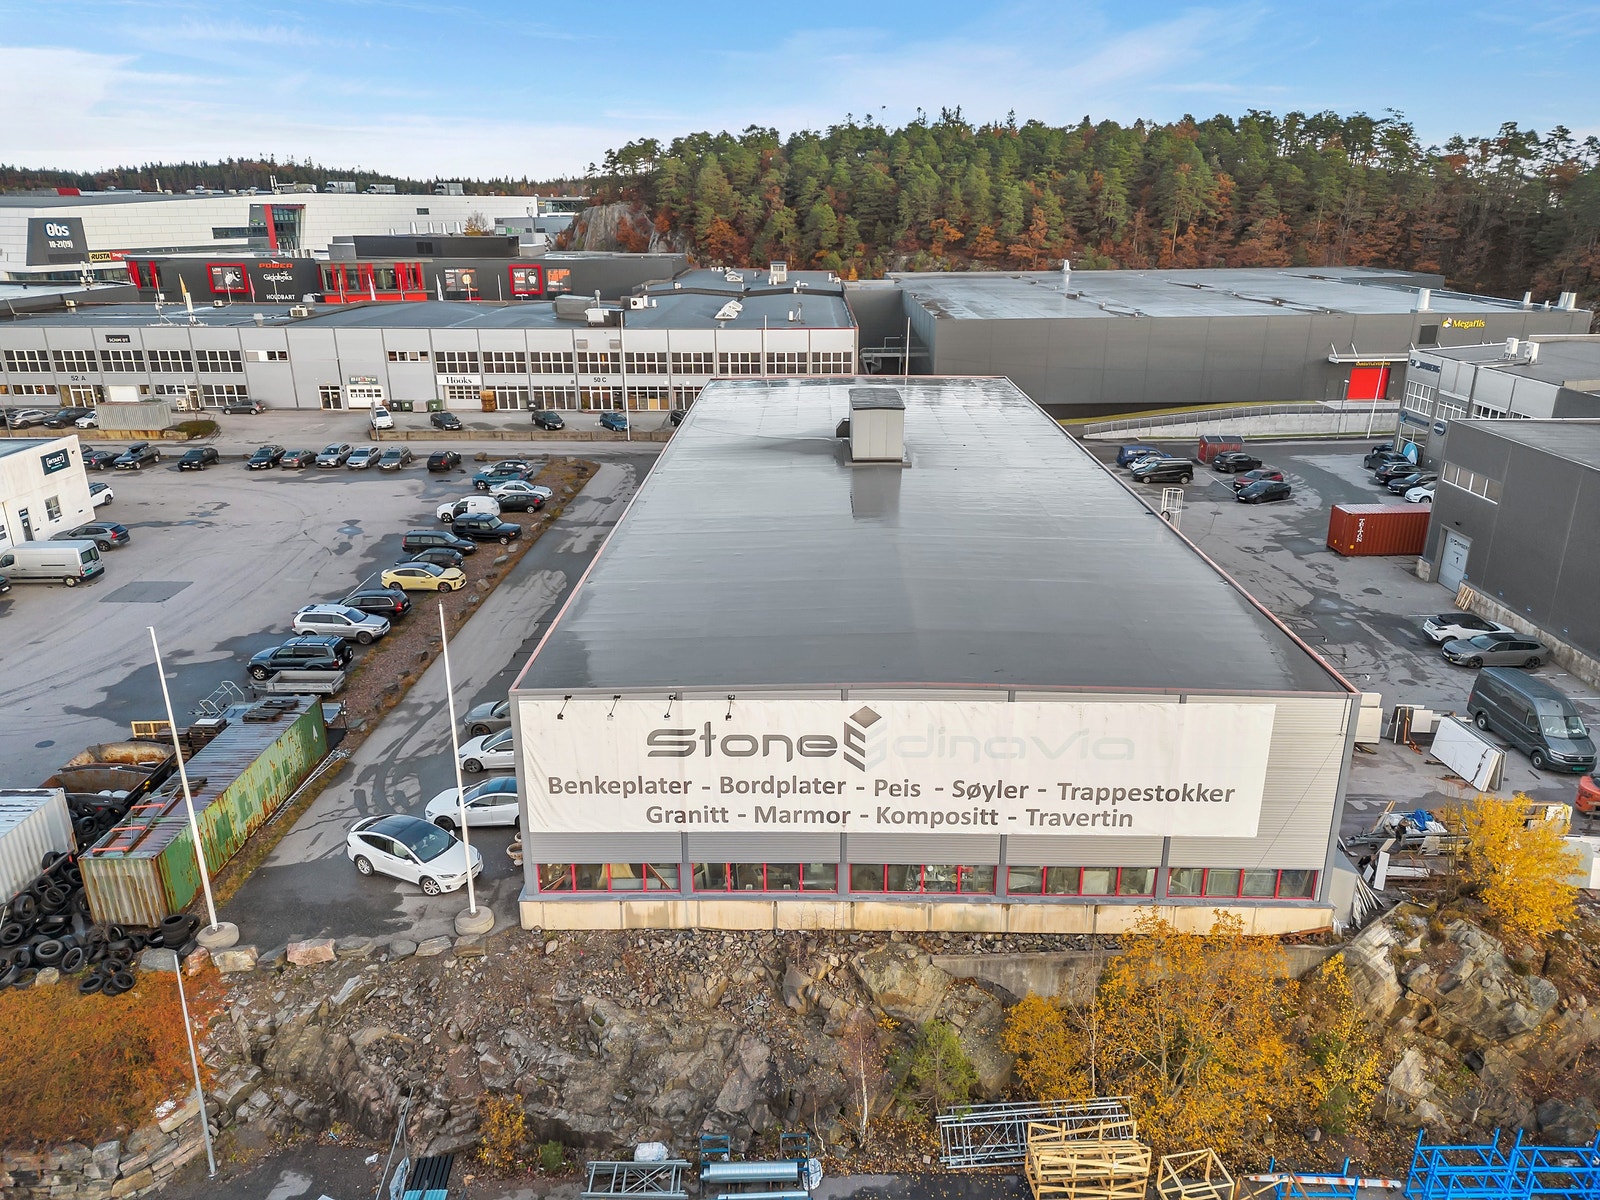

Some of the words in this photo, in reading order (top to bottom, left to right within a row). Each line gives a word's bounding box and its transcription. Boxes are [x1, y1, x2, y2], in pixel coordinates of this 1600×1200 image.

[46, 223, 69, 236] Obs
[1452, 320, 1485, 329] Megaflis
[446, 376, 473, 385] Hööks
[1356, 518, 1365, 543] TRITON
[548, 776, 693, 799] Benkeplater
[720, 776, 847, 799] Bordplater
[874, 779, 921, 798] Peis
[952, 779, 1030, 803] Søyler
[1057, 782, 1236, 804] Trappestokker
[646, 805, 729, 824] Granitt
[754, 805, 851, 824] Marmor
[876, 806, 999, 829] Kompositt
[1025, 808, 1133, 827] Travertin
